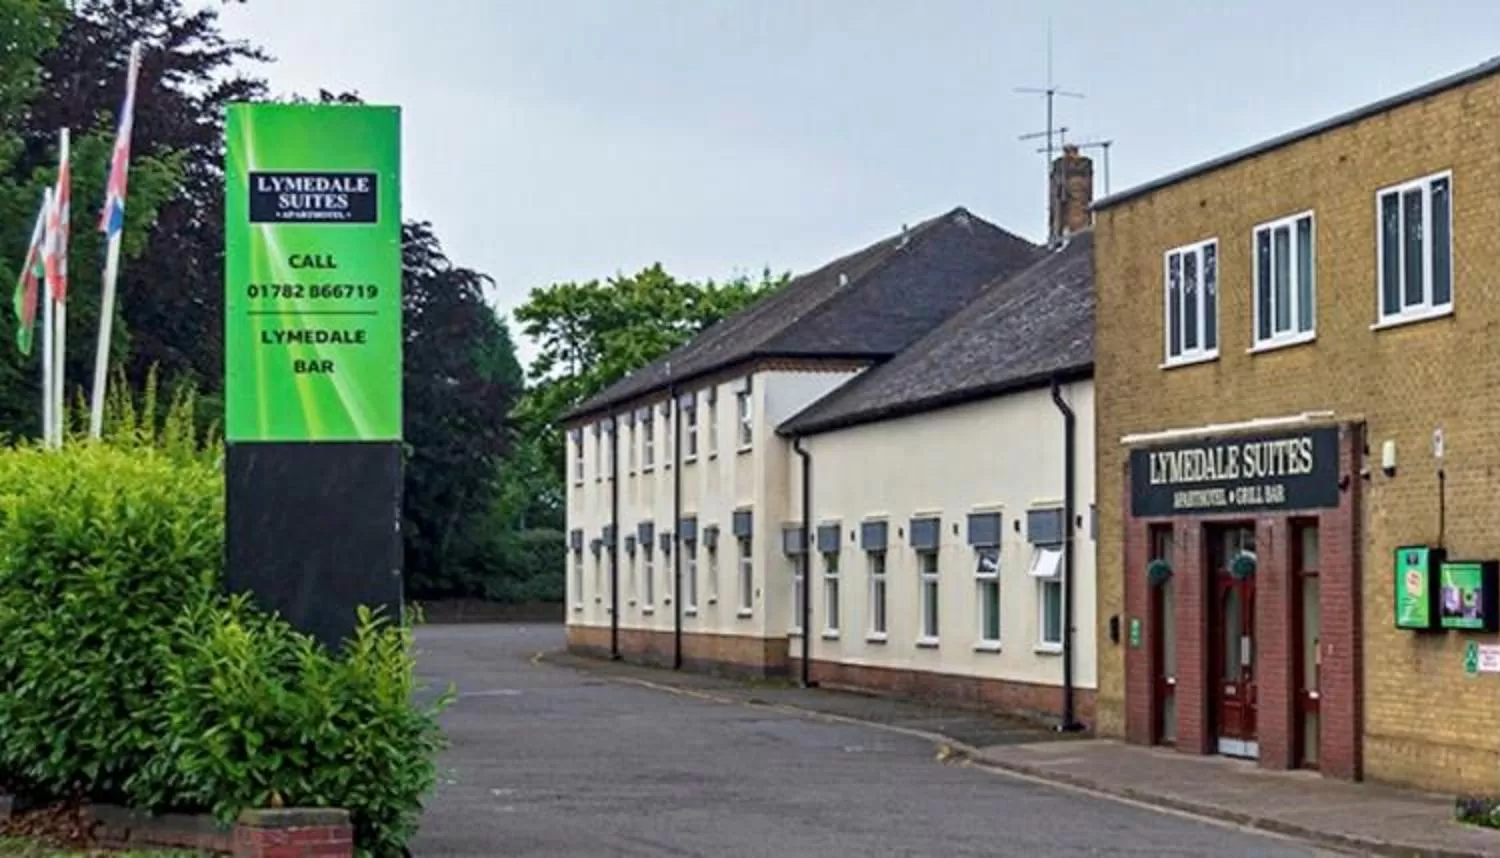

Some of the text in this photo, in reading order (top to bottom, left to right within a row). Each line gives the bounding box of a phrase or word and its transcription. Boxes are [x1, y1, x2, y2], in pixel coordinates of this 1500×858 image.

[258, 176, 369, 192] LYMEDALE
[279, 193, 349, 209] SUITES
[288, 254, 337, 269] CALL
[247, 284, 379, 298] 01782 866719
[261, 330, 367, 344] LYMEDALE
[294, 360, 335, 373] BAR
[1149, 437, 1314, 485] LYMEDALE SUITES
[1236, 485, 1264, 505] GRILL
[1264, 484, 1285, 503] BAR
